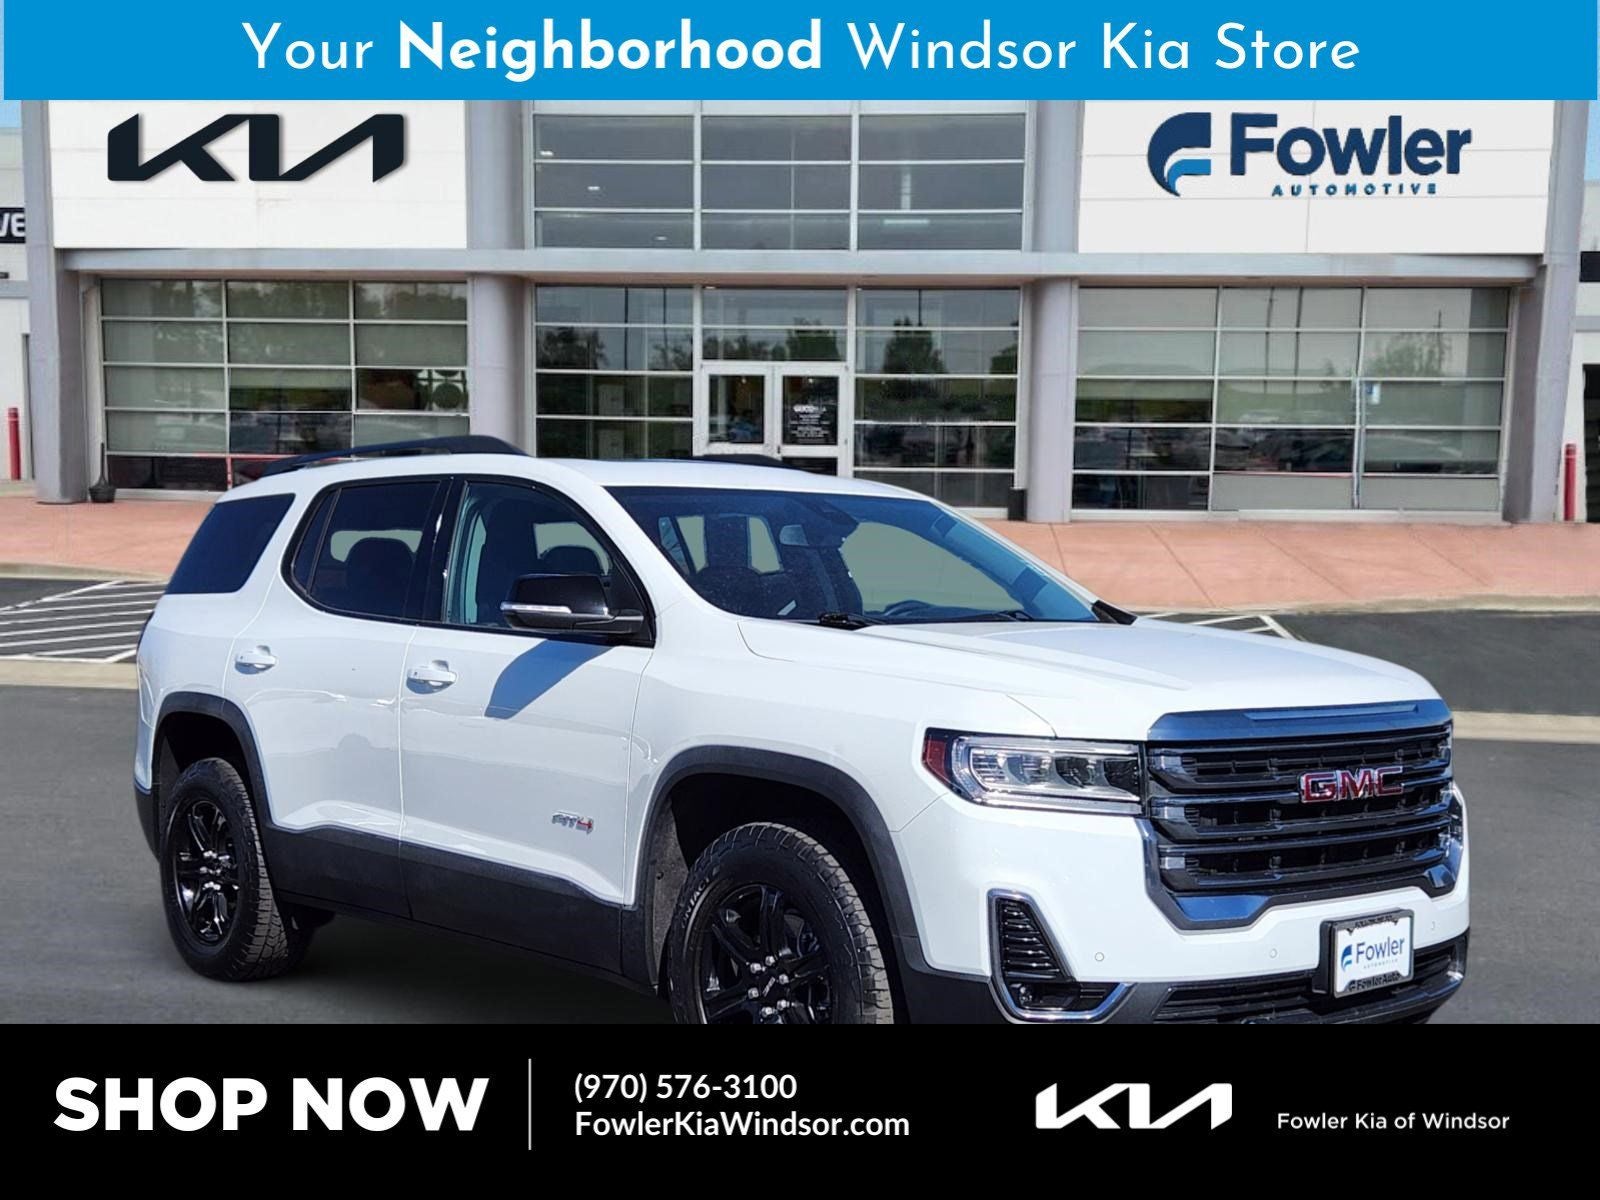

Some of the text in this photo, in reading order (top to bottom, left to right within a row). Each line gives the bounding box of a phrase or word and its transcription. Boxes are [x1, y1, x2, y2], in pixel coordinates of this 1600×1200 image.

[1230, 112, 1472, 176] Fowler
[1271, 182, 1437, 197] AUTOMOTIVE
[1300, 765, 1403, 803] GMC
[1356, 936, 1405, 963] Fowler
